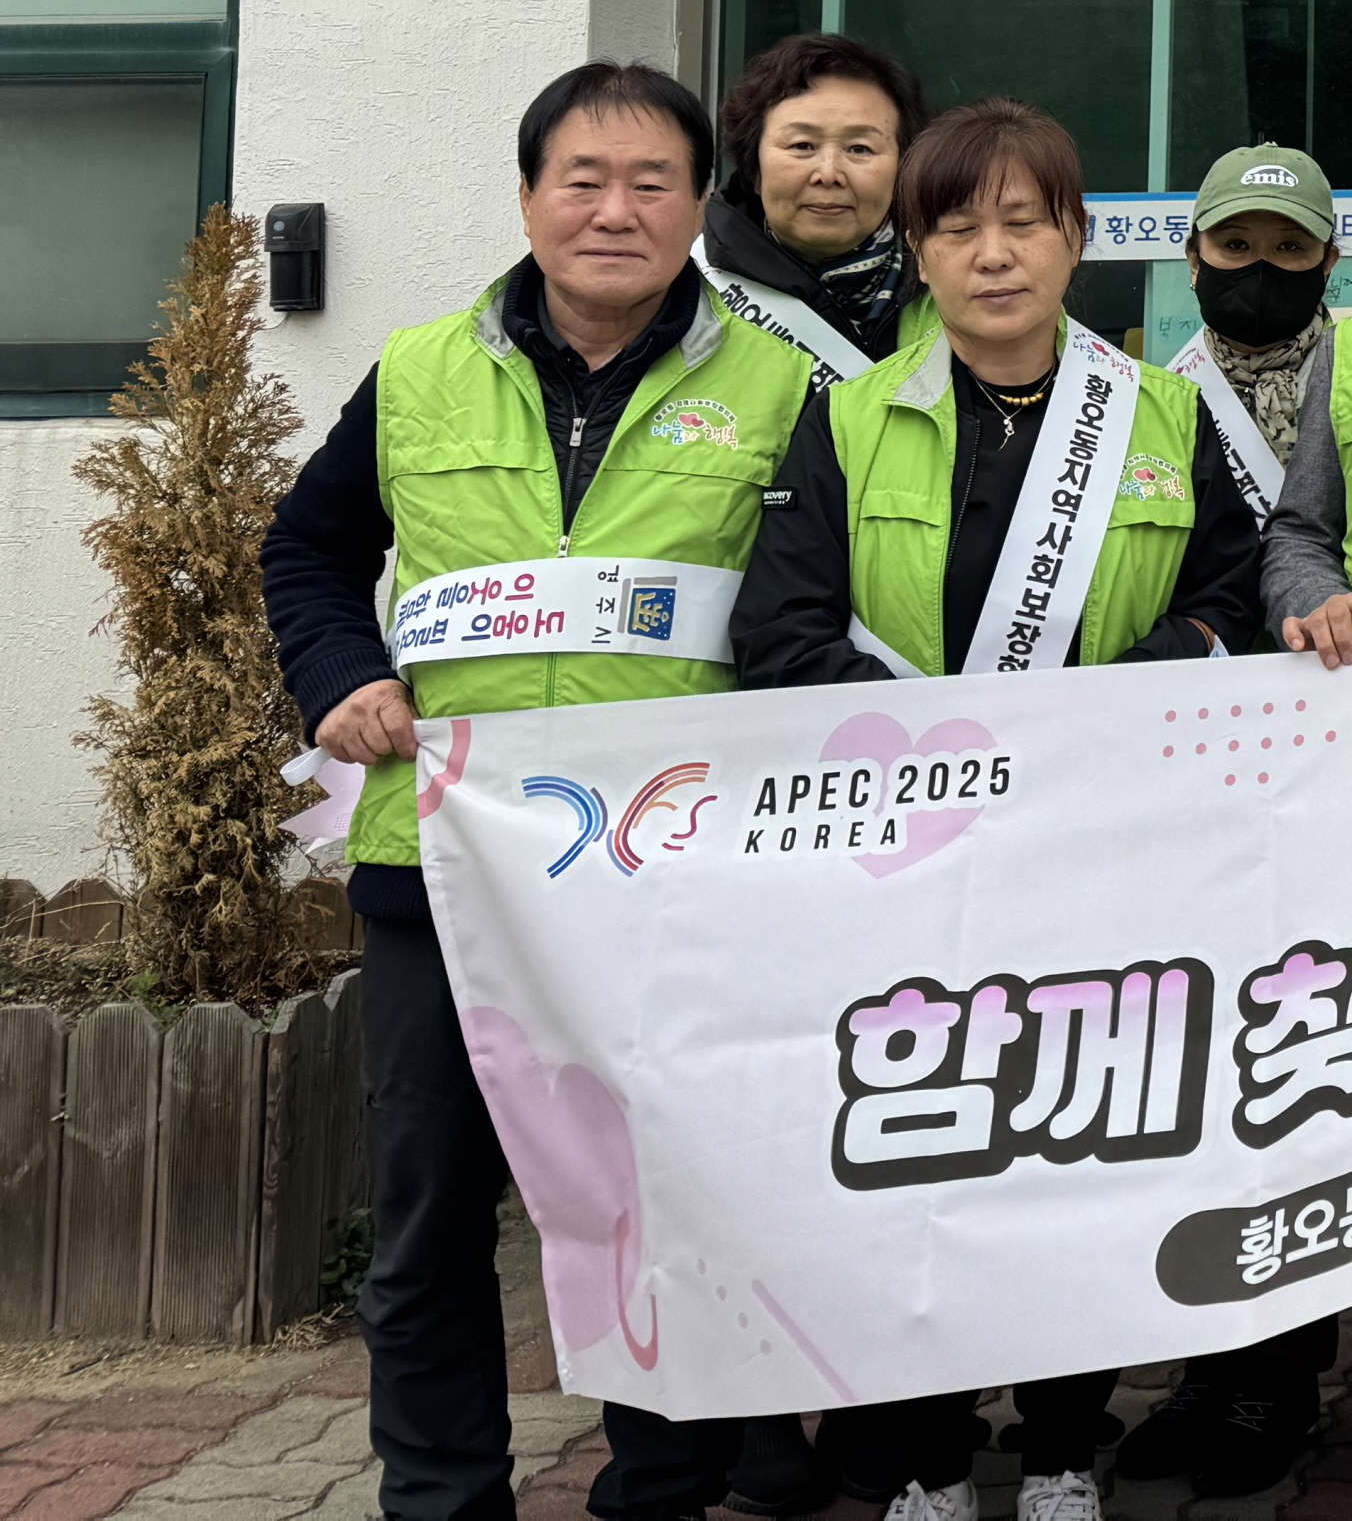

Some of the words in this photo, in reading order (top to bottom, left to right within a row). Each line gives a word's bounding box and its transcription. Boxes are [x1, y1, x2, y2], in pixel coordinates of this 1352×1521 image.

[1243, 170, 1296, 188] emis
[435, 573, 536, 610] 이웃을
[460, 608, 565, 642] 도움이
[754, 768, 871, 818] APEC
[895, 756, 1012, 806] 2025
[744, 818, 897, 855] KOREA
[835, 961, 1208, 1184] 함께
